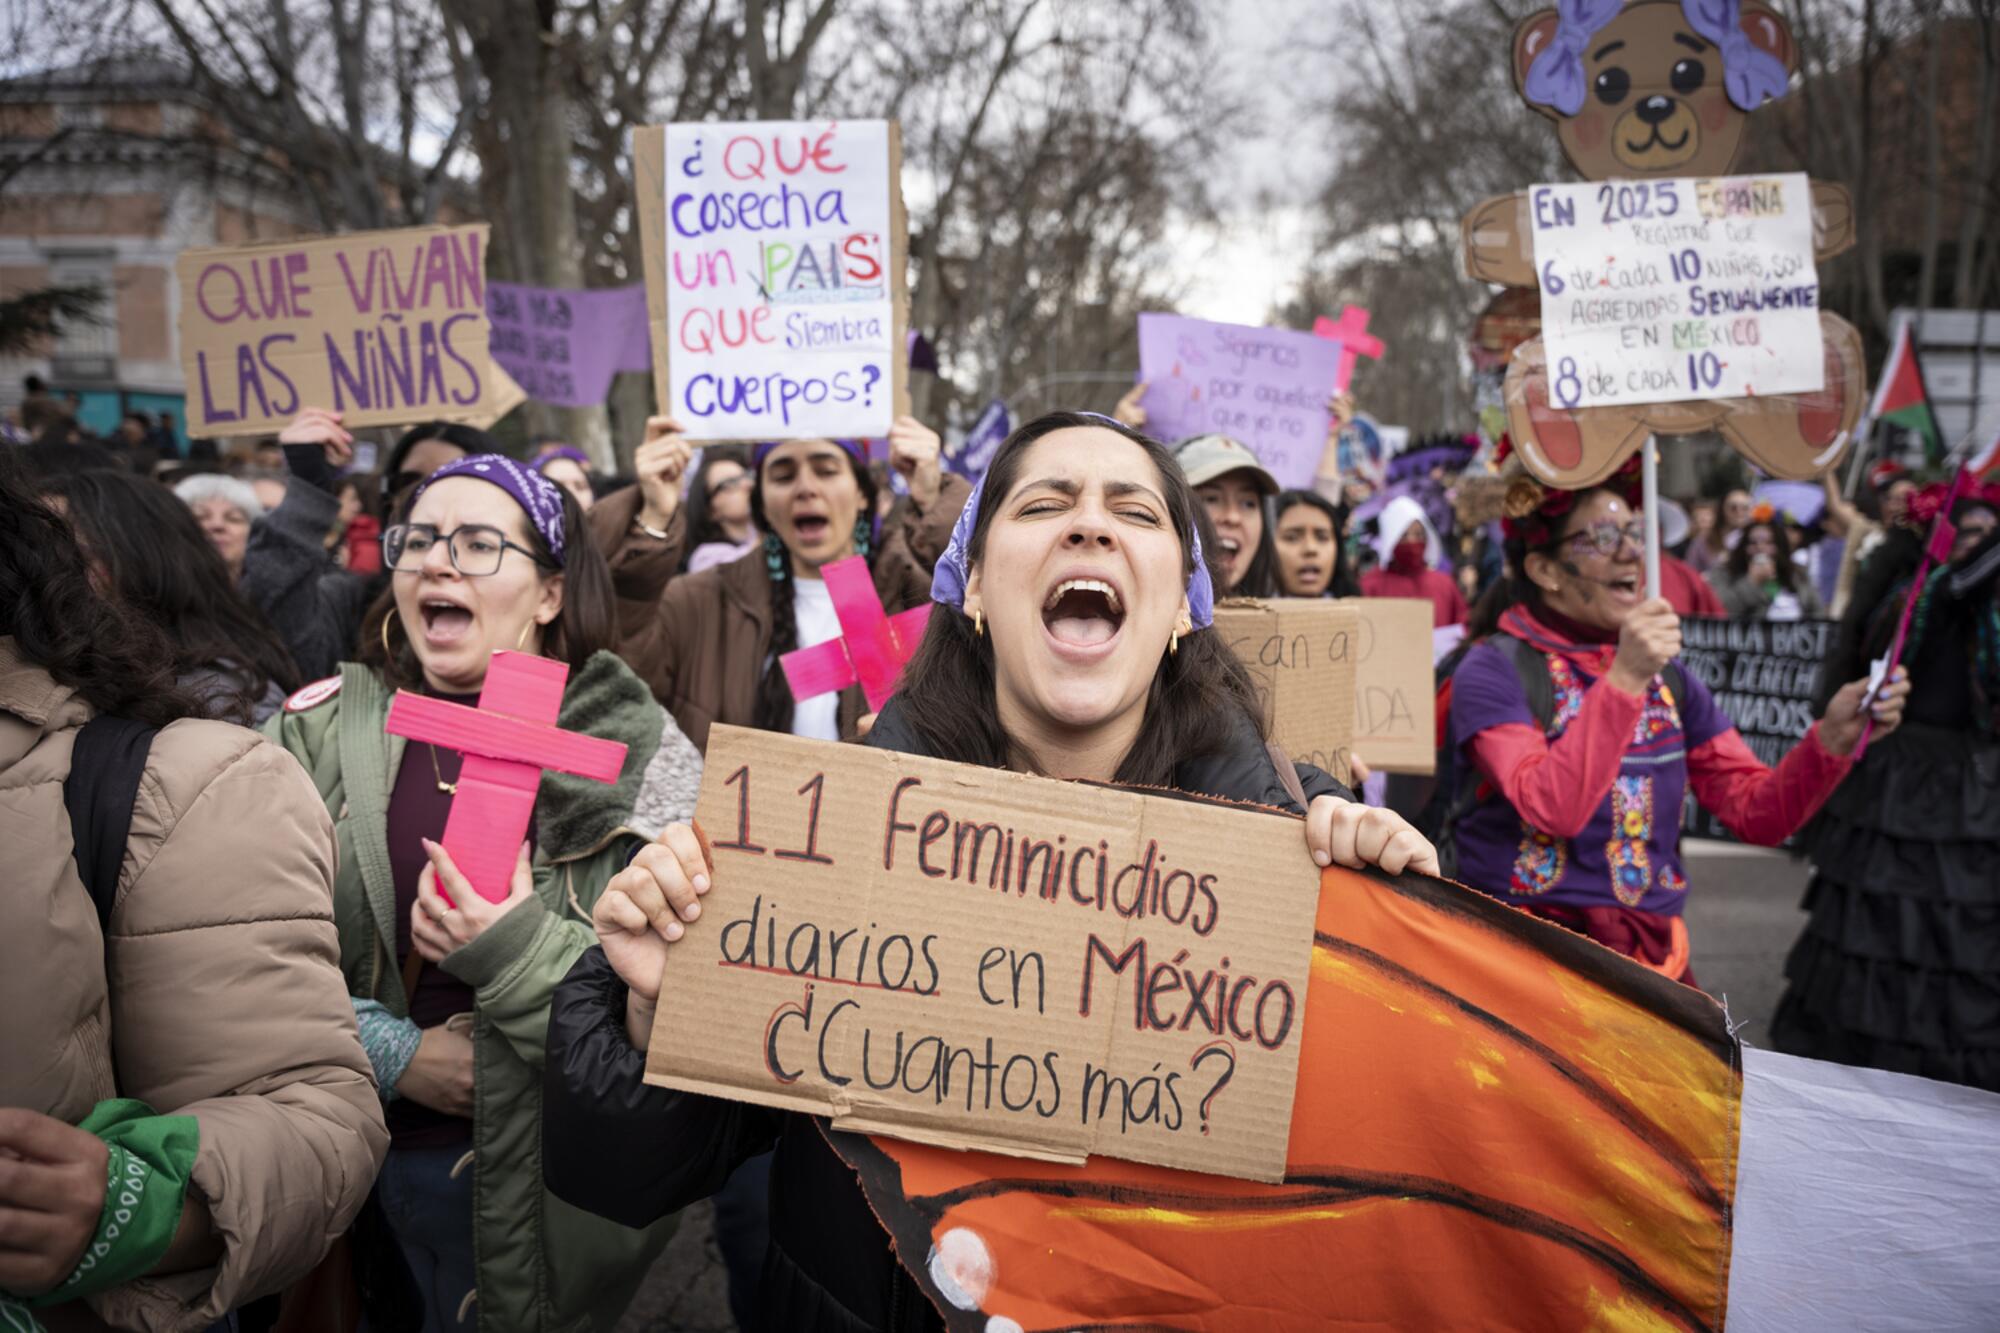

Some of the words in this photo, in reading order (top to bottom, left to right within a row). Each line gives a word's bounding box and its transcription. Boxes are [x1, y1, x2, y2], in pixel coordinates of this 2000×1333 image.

[1534, 187, 1576, 229] EN
[1598, 181, 1679, 224] 2025
[197, 253, 313, 324] QUE
[673, 248, 737, 291] un
[1542, 259, 1566, 296] 6
[1569, 264, 1598, 291] de
[1669, 249, 1702, 283] 10
[1620, 324, 1660, 349] EN
[198, 333, 301, 425] LAS
[1555, 355, 1583, 409] 8
[1587, 362, 1619, 398] de
[1625, 371, 1680, 394] CADA
[1688, 351, 1723, 393] 10
[711, 764, 835, 866] 11
[720, 894, 939, 996] diarios
[977, 946, 1045, 1015] en
[1078, 932, 1296, 1051] México
[1081, 1038, 1236, 1137] más?
